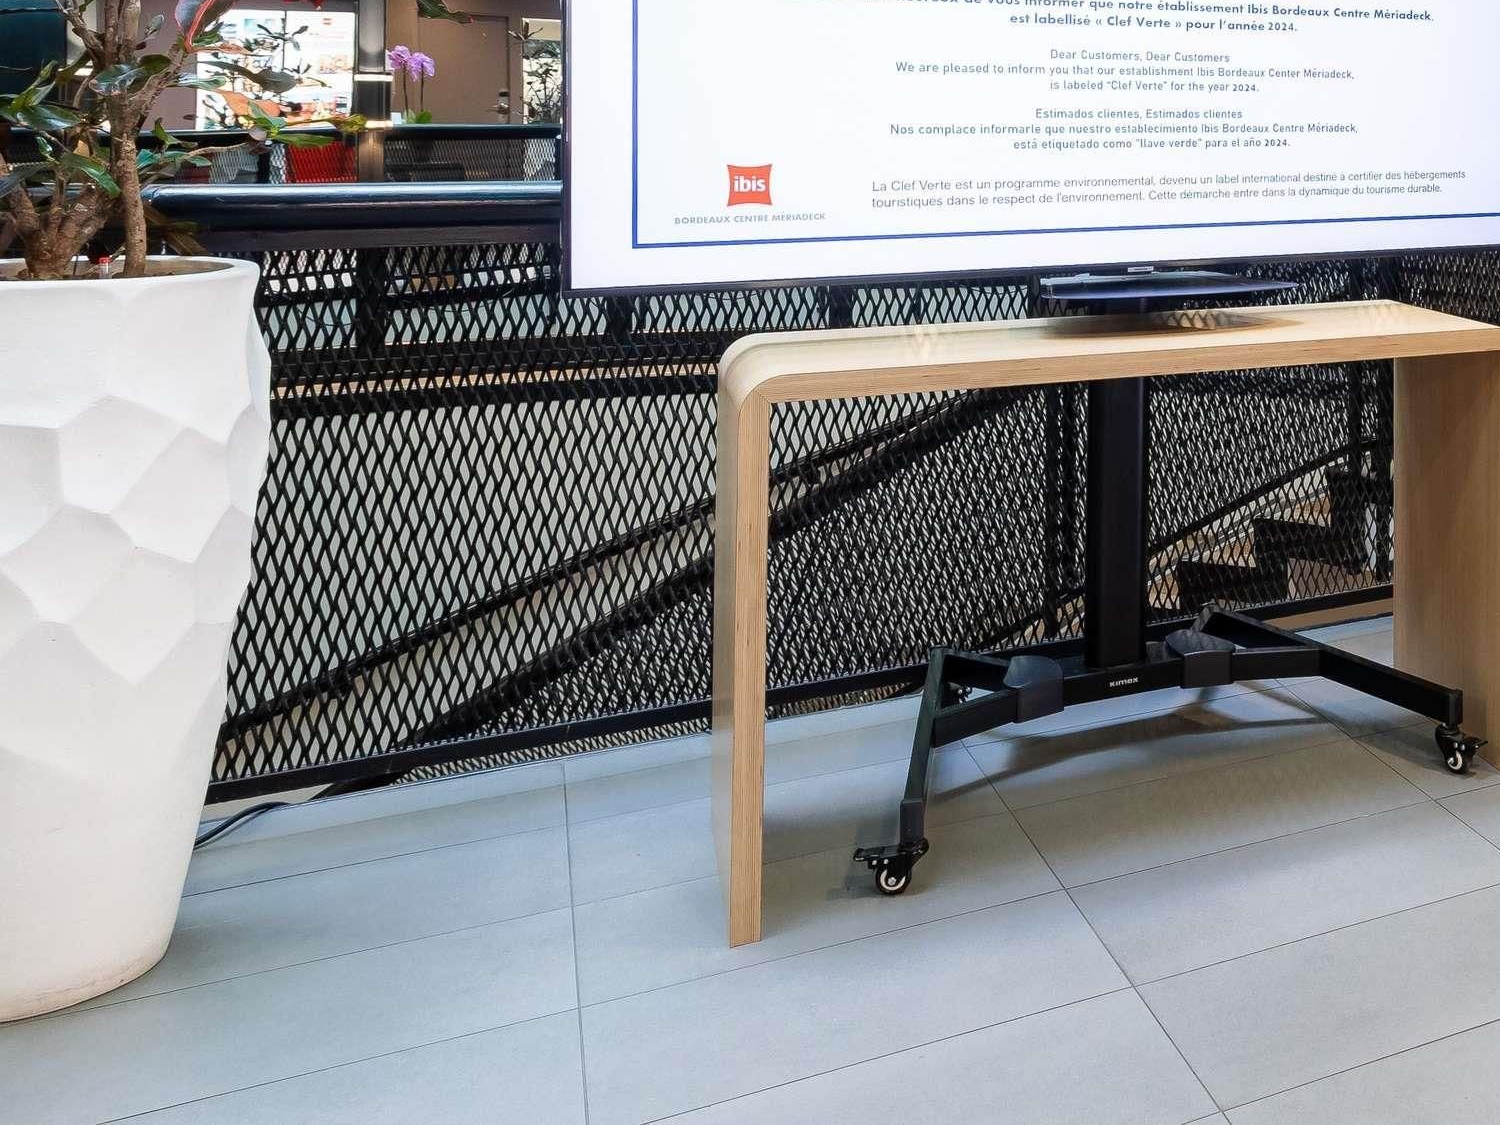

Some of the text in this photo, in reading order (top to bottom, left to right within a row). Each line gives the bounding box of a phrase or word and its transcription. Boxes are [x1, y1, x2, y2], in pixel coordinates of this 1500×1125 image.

[1089, 0, 1114, 12] que
[1118, 0, 1153, 11] notre
[1156, 0, 1244, 15] établissement
[1247, 3, 1269, 15] Ibis
[1271, 4, 1330, 18] Bordeaux
[1333, 7, 1371, 19] Centre
[1009, 13, 1031, 24] est
[1106, 14, 1132, 27] Clef
[1135, 16, 1172, 28] Verte
[1185, 21, 1216, 33] pour
[1267, 21, 1298, 32] 2024.
[1050, 48, 1077, 60] Dear
[1145, 50, 1172, 62] Dear
[1174, 50, 1231, 63] Customers
[895, 61, 916, 73] We
[918, 63, 940, 73] are
[942, 62, 989, 76] pleased
[992, 64, 1004, 76] to
[1007, 63, 1046, 75] inform
[1049, 66, 1069, 77] you
[1072, 64, 1094, 75] that
[1096, 66, 1116, 76] our
[1118, 65, 1194, 77] establishment
[1196, 65, 1215, 77] Ibis
[1217, 66, 1266, 78] Bordeaux
[1268, 66, 1301, 79] Center
[1050, 81, 1060, 91] is
[1063, 79, 1104, 91] labeled
[1170, 80, 1186, 92] for
[1188, 81, 1205, 92] the
[1207, 83, 1230, 94] year
[1232, 83, 1260, 92] 2024.
[1035, 107, 1095, 119] Estimados
[1145, 108, 1201, 119] Estimados
[1202, 108, 1243, 119] clientes
[890, 123, 915, 136] Nos
[917, 123, 977, 137] complace
[979, 123, 1042, 135] informarle
[1044, 125, 1066, 137] que
[1068, 124, 1112, 134] nuestro
[1114, 122, 1198, 134] establecimiento
[1201, 122, 1220, 134] Ibis
[1221, 122, 1270, 134] Bordeaux
[1272, 122, 1305, 133] Centre
[1013, 137, 1038, 150] está
[1040, 138, 1100, 152] etiquetado
[1102, 140, 1133, 149] como
[1204, 139, 1228, 151] para
[1230, 137, 1241, 148] el
[1242, 137, 1262, 148] año
[1263, 138, 1291, 148] 2024.
[733, 175, 767, 193] ibis
[871, 180, 888, 192] La
[890, 179, 917, 192] Clef
[917, 178, 952, 191] Verte
[954, 178, 974, 190] est
[976, 181, 992, 190] un
[994, 178, 1061, 192] programme
[1159, 174, 1198, 186] devenu
[1199, 176, 1213, 185] un
[1215, 173, 1240, 184] label
[1241, 170, 1301, 183] international
[1384, 170, 1402, 181] des
[871, 194, 944, 210] touristiques
[946, 195, 976, 206] dans
[978, 194, 990, 205] le
[992, 193, 1036, 208] respect
[1038, 193, 1054, 204] de
[1147, 189, 1177, 201] Cette
[1232, 188, 1260, 199] entre
[1261, 187, 1286, 198] dans
[1287, 186, 1297, 197] la
[1298, 185, 1351, 199] dynamique
[1351, 185, 1365, 195] du
[1366, 185, 1406, 196] tourisme
[1406, 183, 1443, 194] durable.
[674, 215, 731, 226] BORDEAUX
[732, 214, 768, 223] CENTRE
